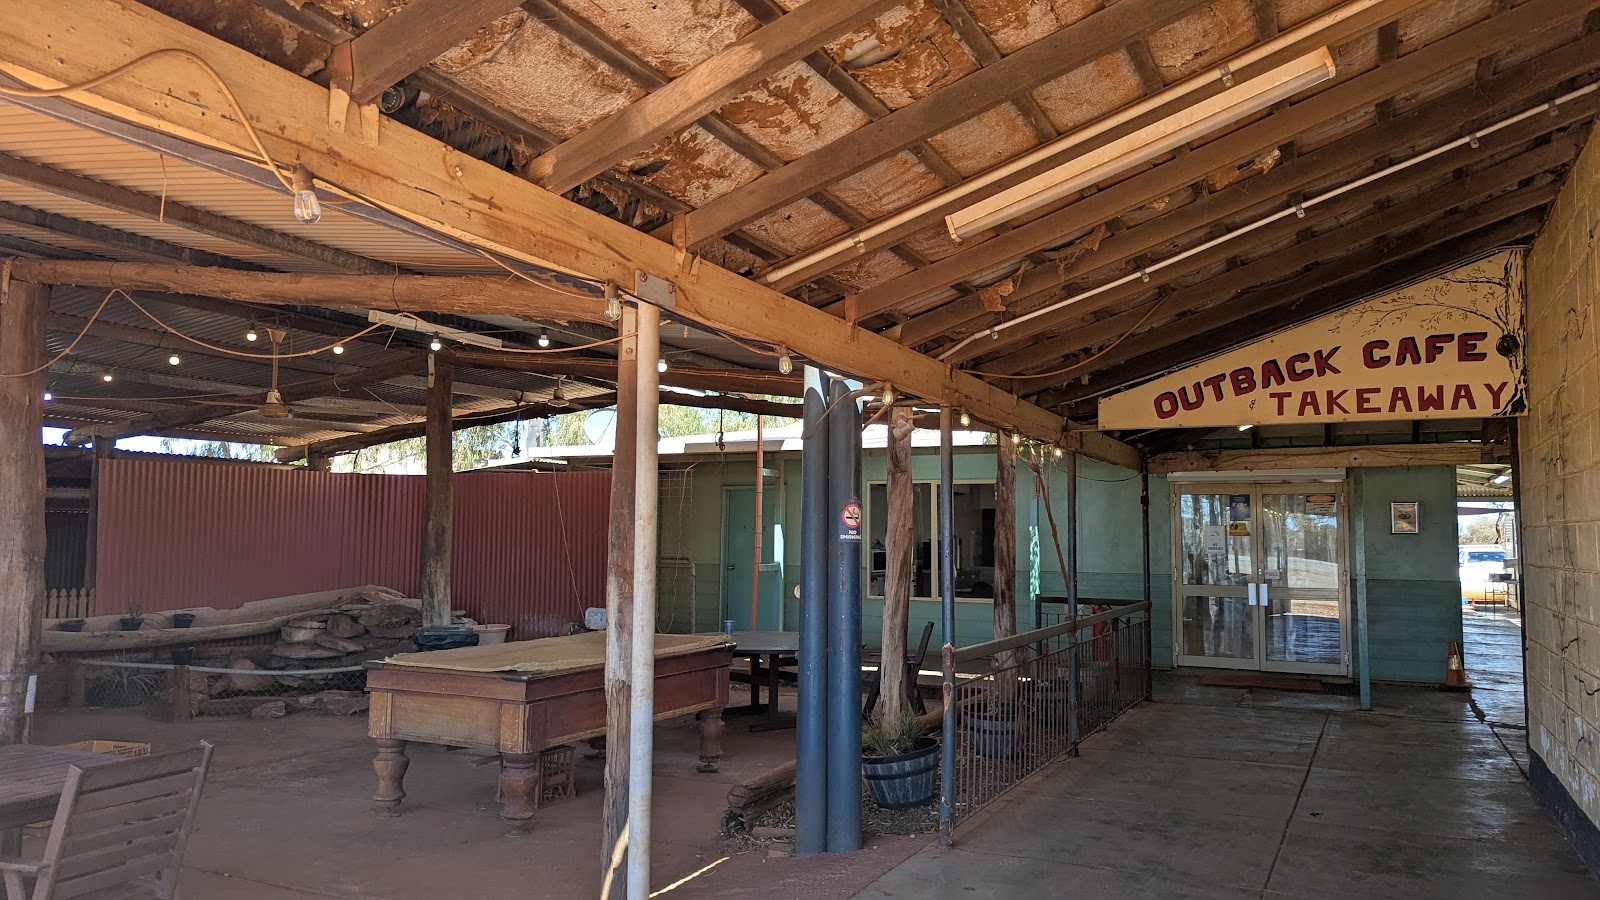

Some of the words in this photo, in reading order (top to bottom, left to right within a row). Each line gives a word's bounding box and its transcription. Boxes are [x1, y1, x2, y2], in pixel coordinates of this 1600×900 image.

[1153, 345, 1342, 420] OUTBACK
[1362, 332, 1488, 369] CAFE
[1269, 381, 1508, 416] TAKEAWAY
